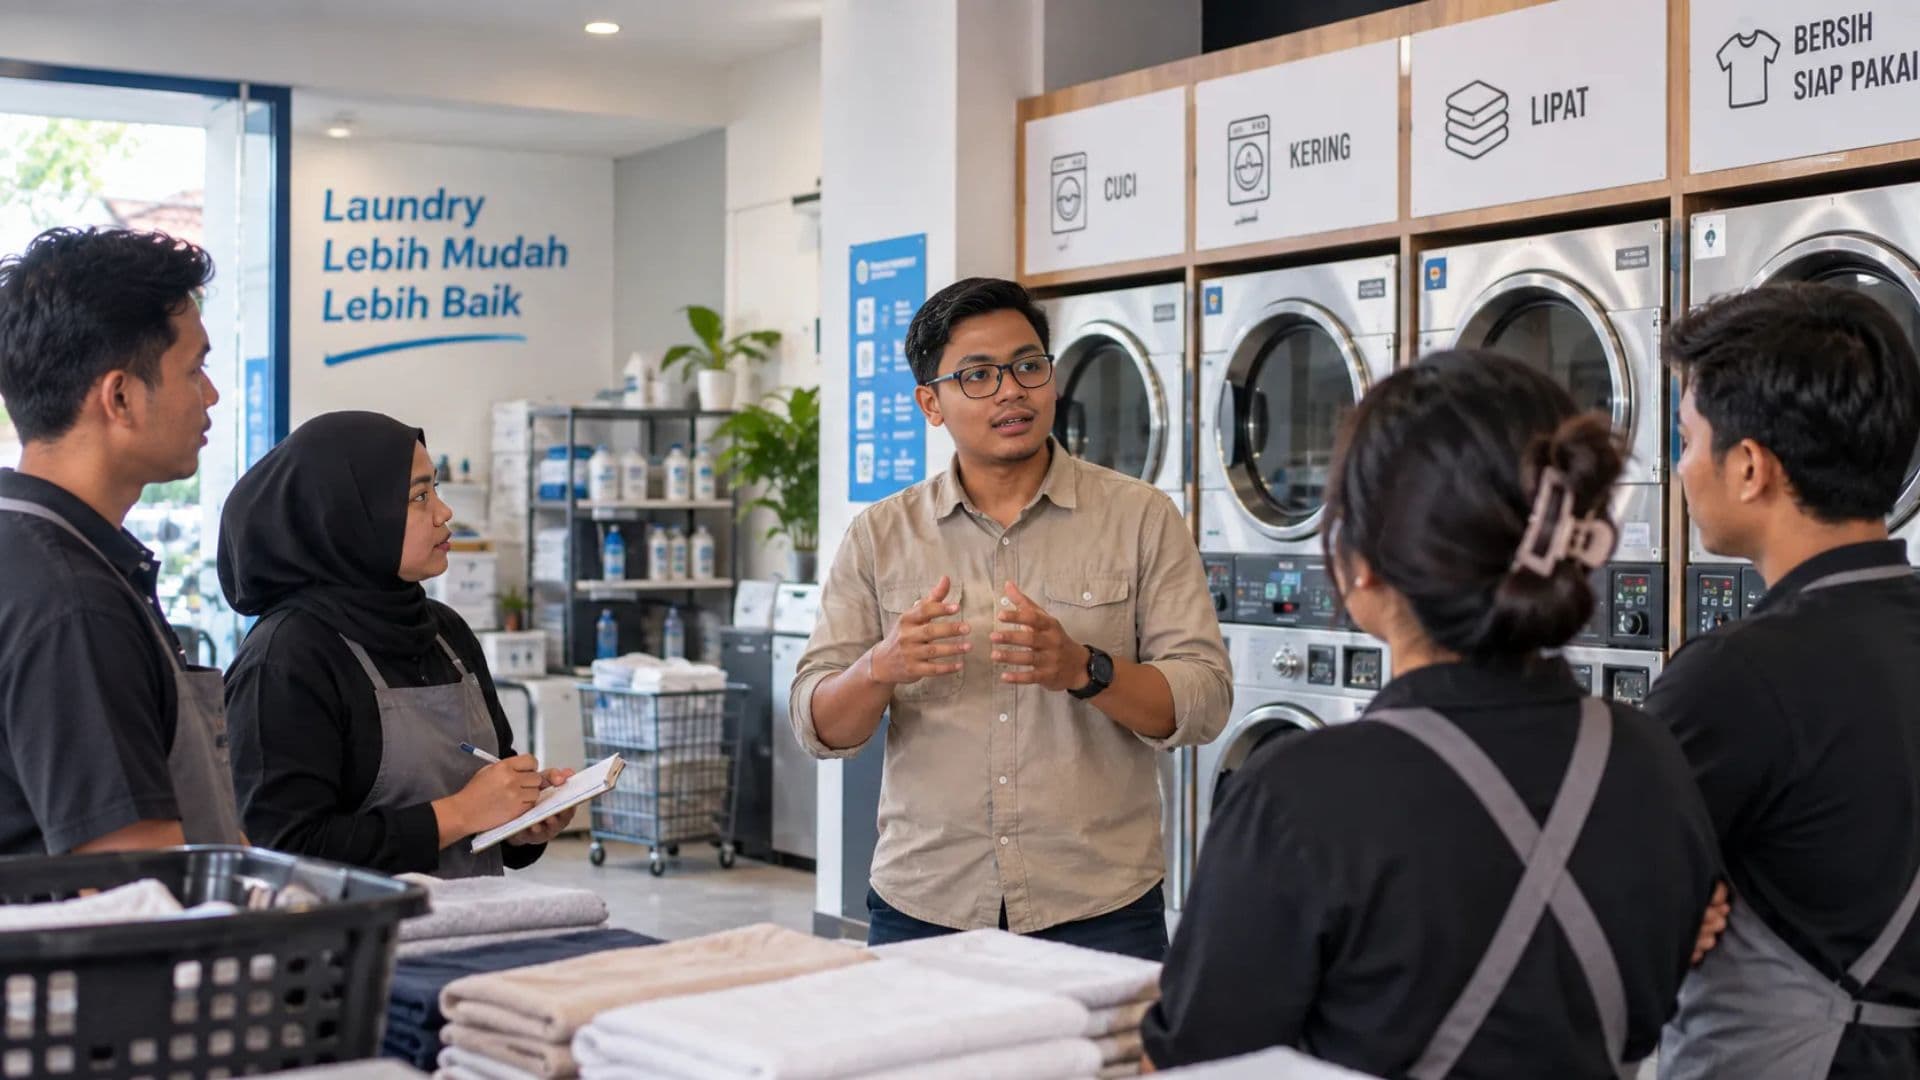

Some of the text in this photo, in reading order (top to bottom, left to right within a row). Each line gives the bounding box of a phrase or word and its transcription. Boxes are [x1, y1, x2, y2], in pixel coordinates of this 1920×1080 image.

[1794, 11, 1873, 55] BERSIH
[1793, 50, 1918, 101] SIAP PAKAI
[1531, 85, 1589, 126] LIPAT
[1289, 132, 1351, 169] KERING
[1103, 172, 1137, 203] CUCI
[323, 186, 486, 230] Laundry
[323, 234, 569, 273] Lebih Mudah
[322, 284, 521, 323] Lebih Baik
